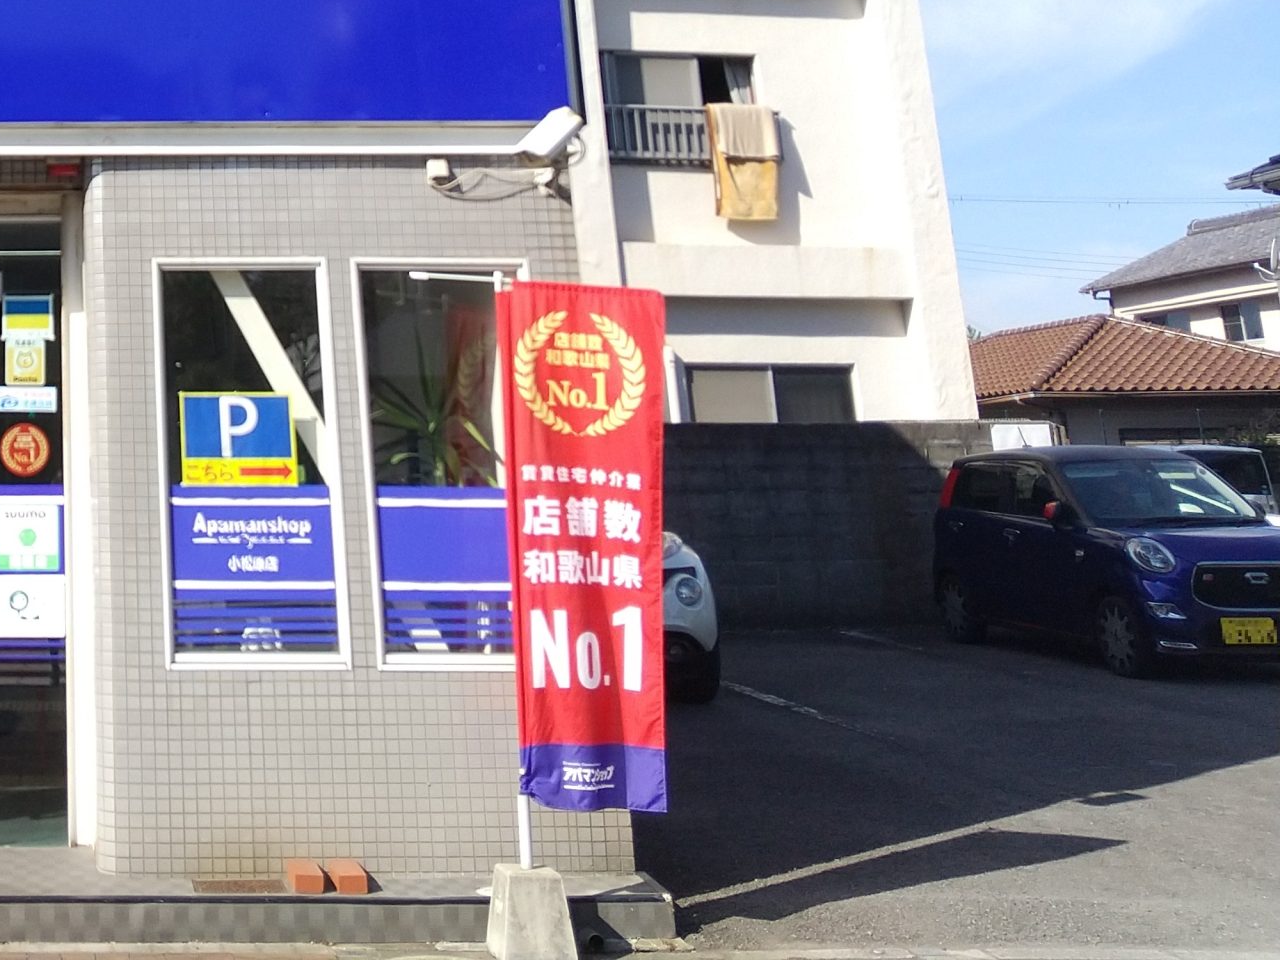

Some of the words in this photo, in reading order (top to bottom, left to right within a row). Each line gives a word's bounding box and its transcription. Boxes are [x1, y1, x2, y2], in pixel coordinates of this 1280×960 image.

[545, 371, 610, 411] No.1
[217, 395, 260, 458] P
[186, 463, 234, 482] こちら
[193, 512, 312, 537] Apamanshop
[522, 495, 642, 544] 店舗数
[524, 549, 643, 590] 和歌山県
[529, 605, 643, 692] No.1
